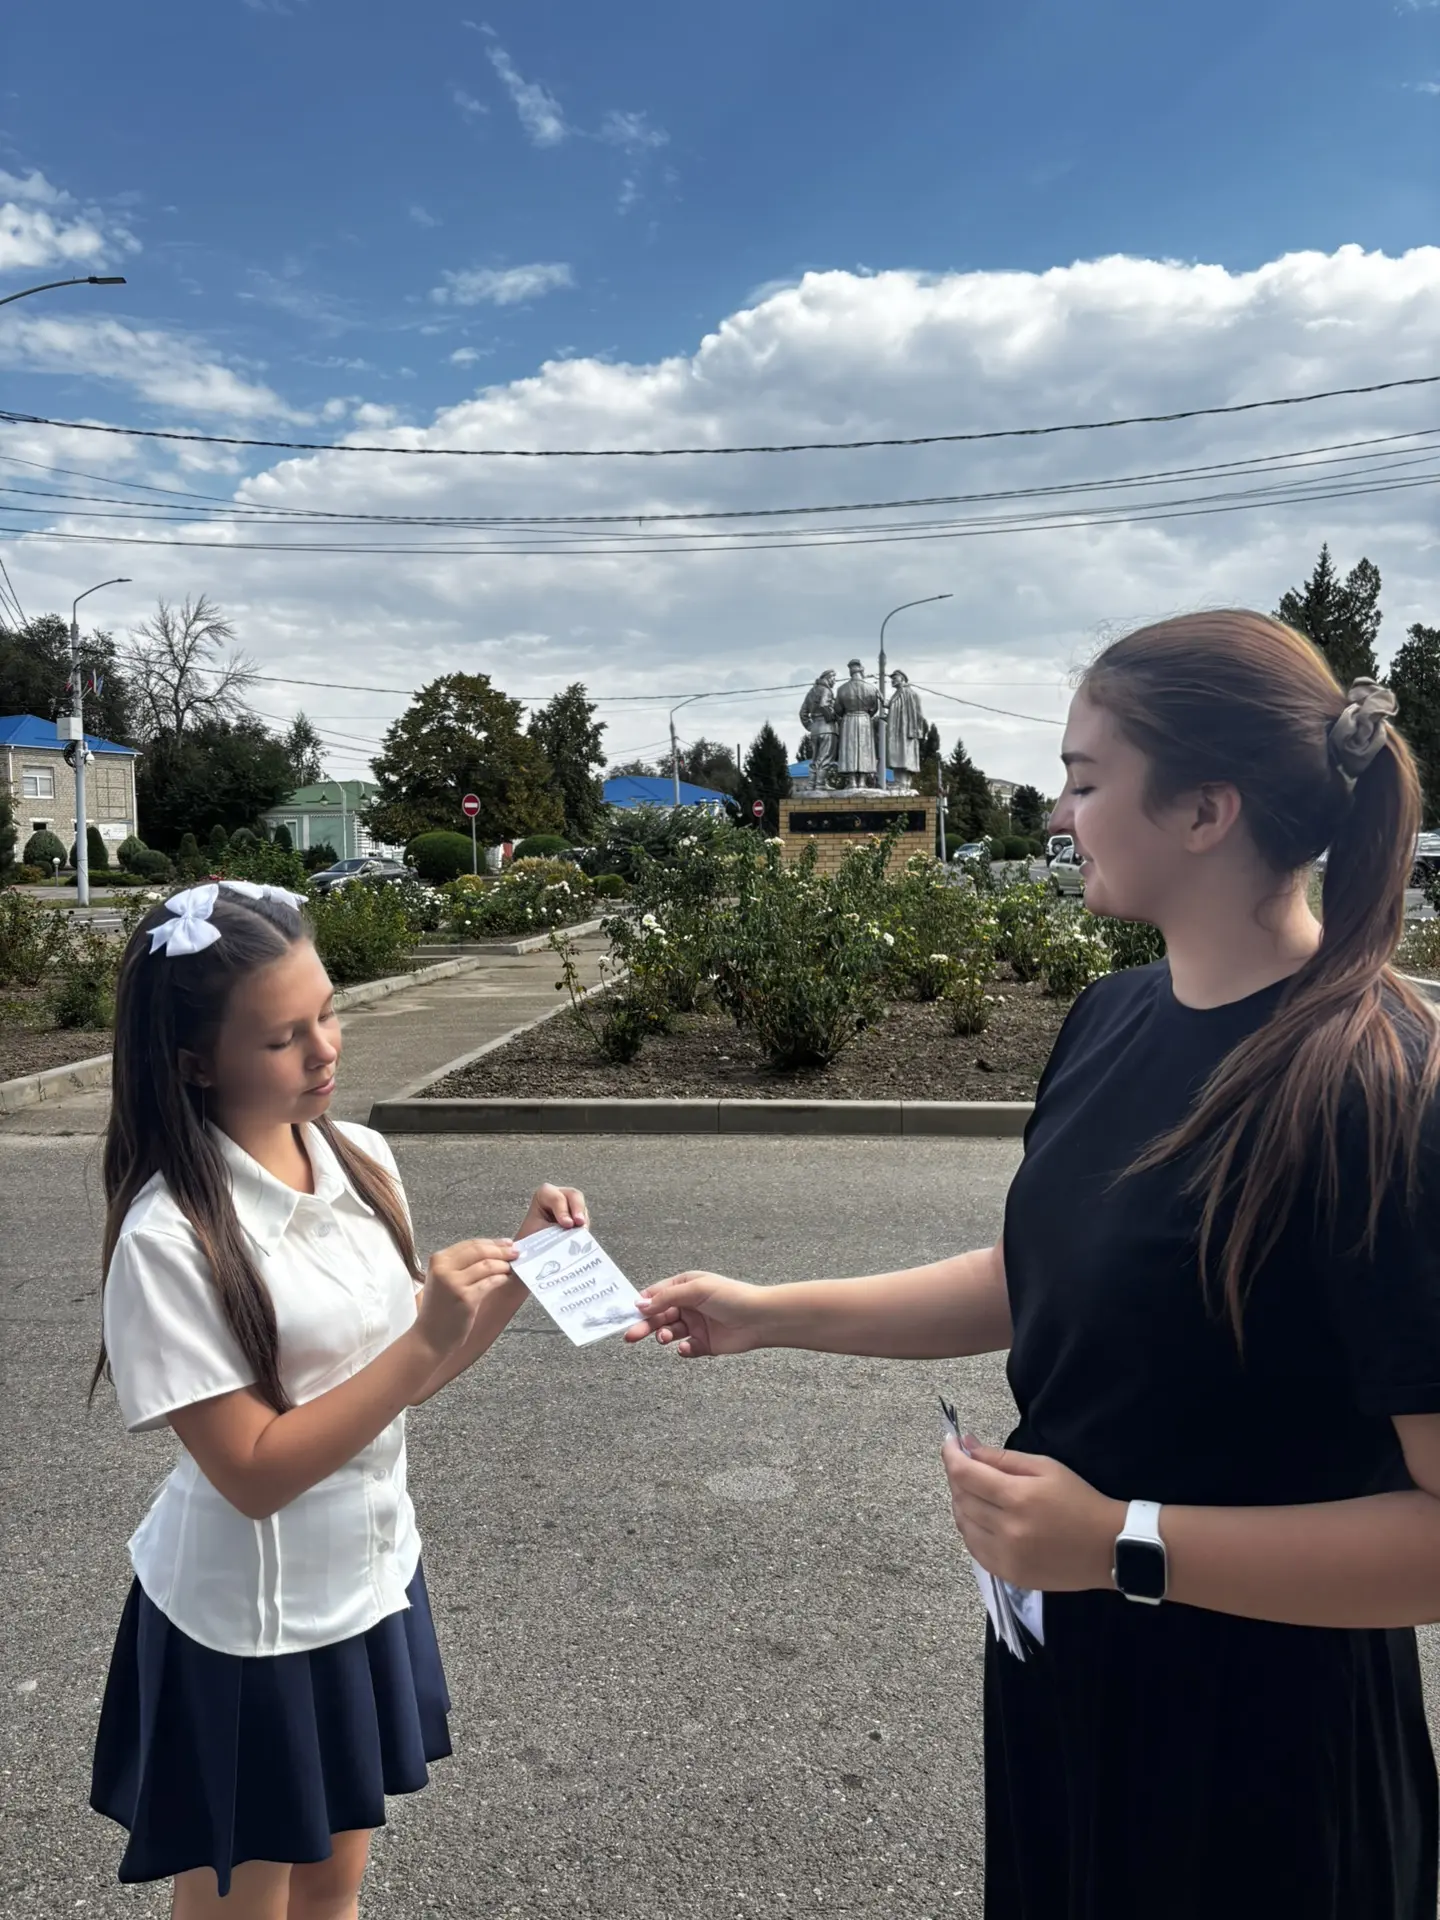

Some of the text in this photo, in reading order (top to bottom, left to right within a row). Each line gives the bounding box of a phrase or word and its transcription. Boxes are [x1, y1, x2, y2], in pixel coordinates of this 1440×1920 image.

[538, 1257, 602, 1290] Сохраним
[563, 1277, 597, 1297] нашу
[560, 1282, 620, 1313] природу!
